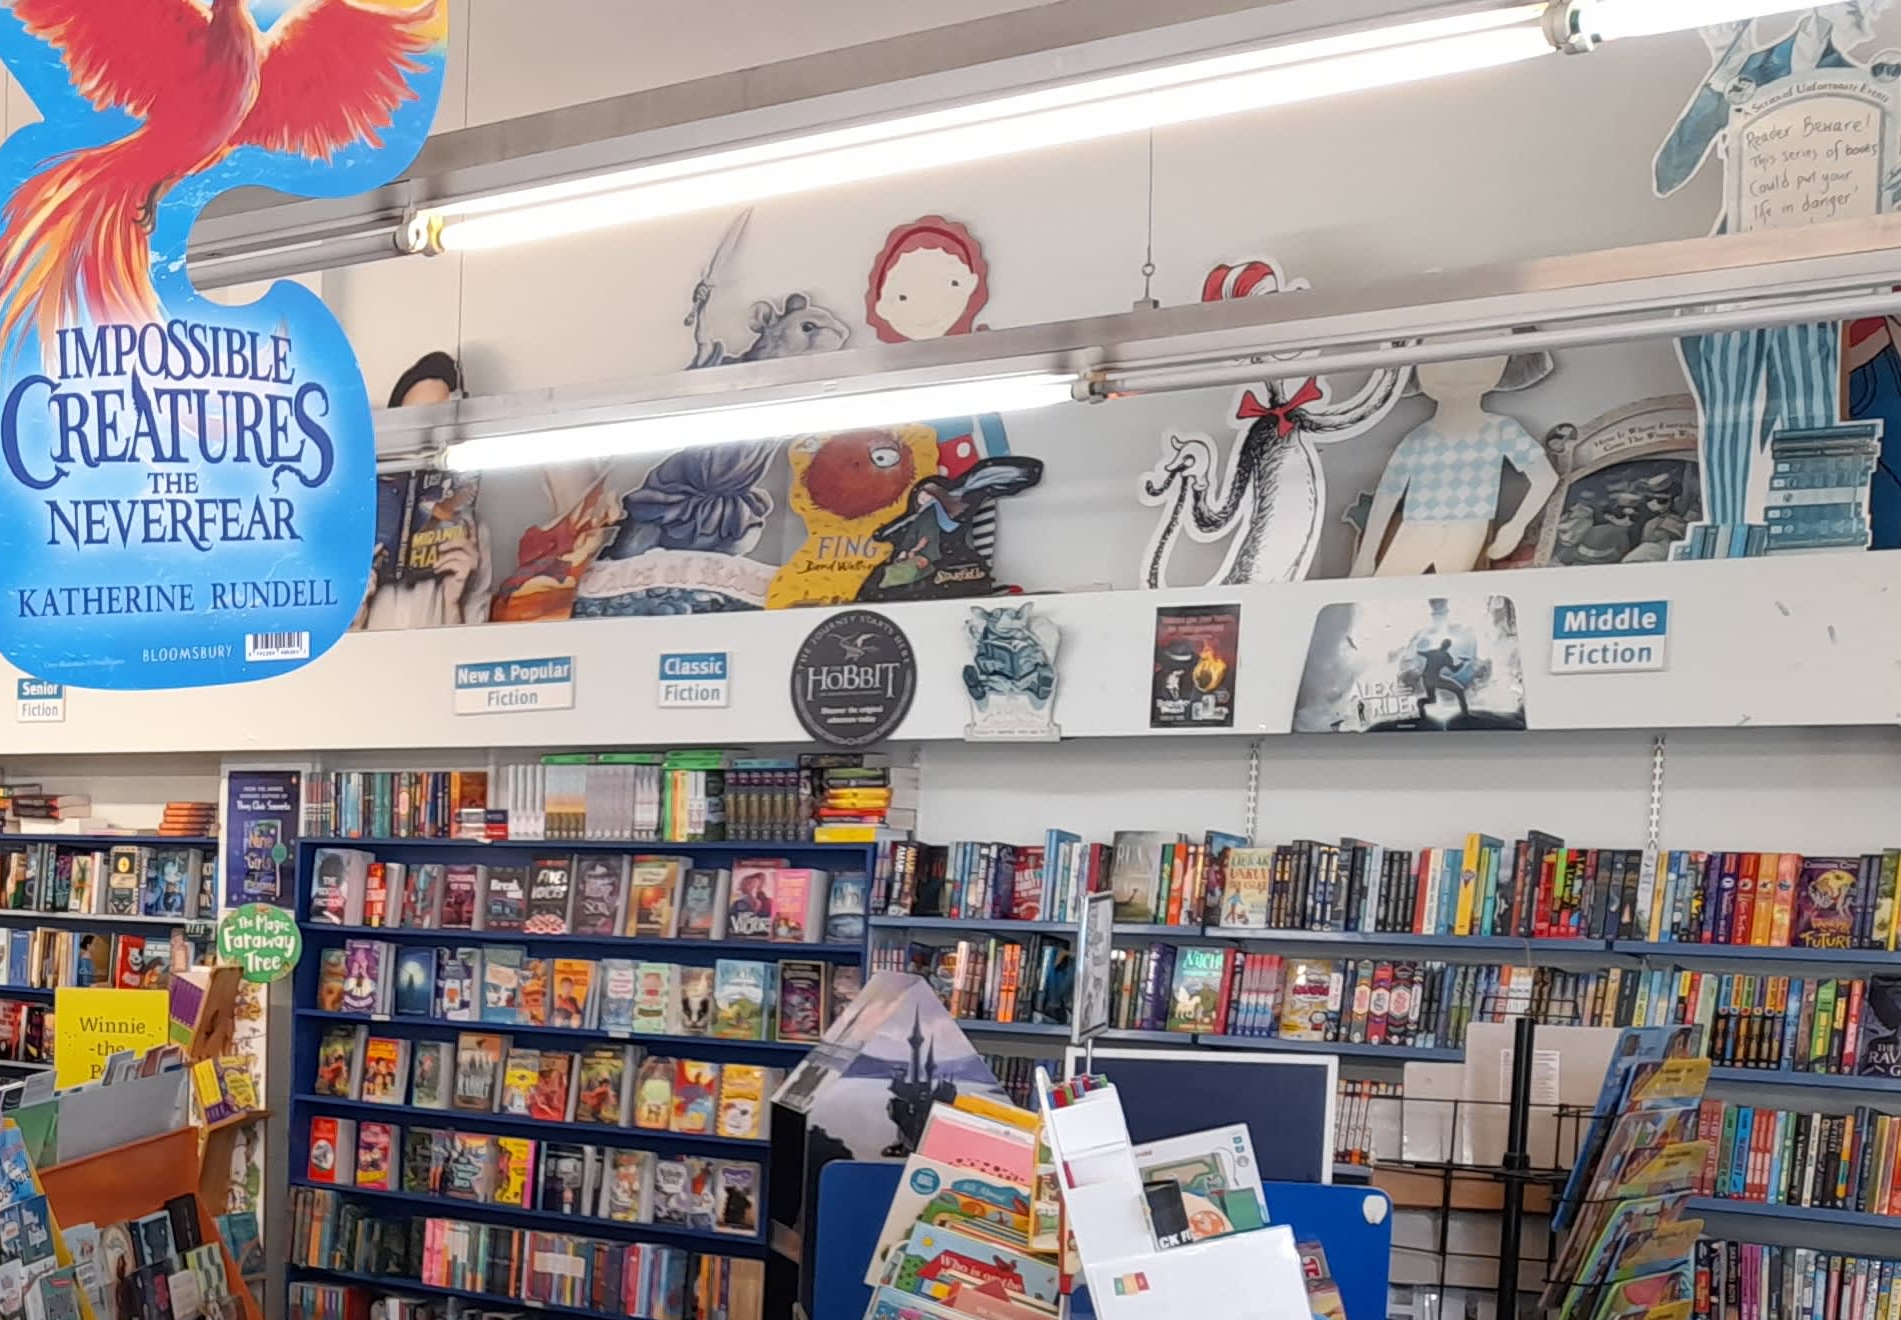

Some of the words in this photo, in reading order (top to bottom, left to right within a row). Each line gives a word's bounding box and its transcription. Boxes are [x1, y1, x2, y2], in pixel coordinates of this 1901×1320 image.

[1746, 126, 1792, 150] Reader
[1782, 150, 1817, 162] series
[1826, 139, 1843, 161] of
[1821, 170, 1853, 195] your
[56, 318, 296, 385] IMPOSSIBLE
[1, 363, 335, 490] CREATURES
[148, 471, 199, 494] THE
[45, 495, 303, 552] NEVERFEAR
[817, 535, 878, 560] FING
[17, 584, 195, 618] KATHERINE
[211, 579, 339, 609] RUNDELL
[1564, 607, 1658, 633] Middle
[142, 644, 233, 664] BLOOMSBURY
[1564, 640, 1652, 667] Fiction
[457, 668, 490, 685] New
[494, 667, 505, 682] &
[510, 662, 569, 682] Popular
[665, 657, 724, 676] Classic
[22, 682, 59, 697] Senior
[487, 689, 539, 707] Fiction
[665, 684, 720, 701] Fiction
[1351, 680, 1397, 699] ALEX
[21, 701, 60, 718] Fiction
[1370, 697, 1420, 718] RIDER
[238, 916, 255, 930] The
[256, 915, 290, 932] Magic
[224, 926, 296, 957] Faraway
[244, 951, 282, 973] Tree
[79, 1014, 147, 1036] Winnie
[939, 1254, 968, 1274] Who
